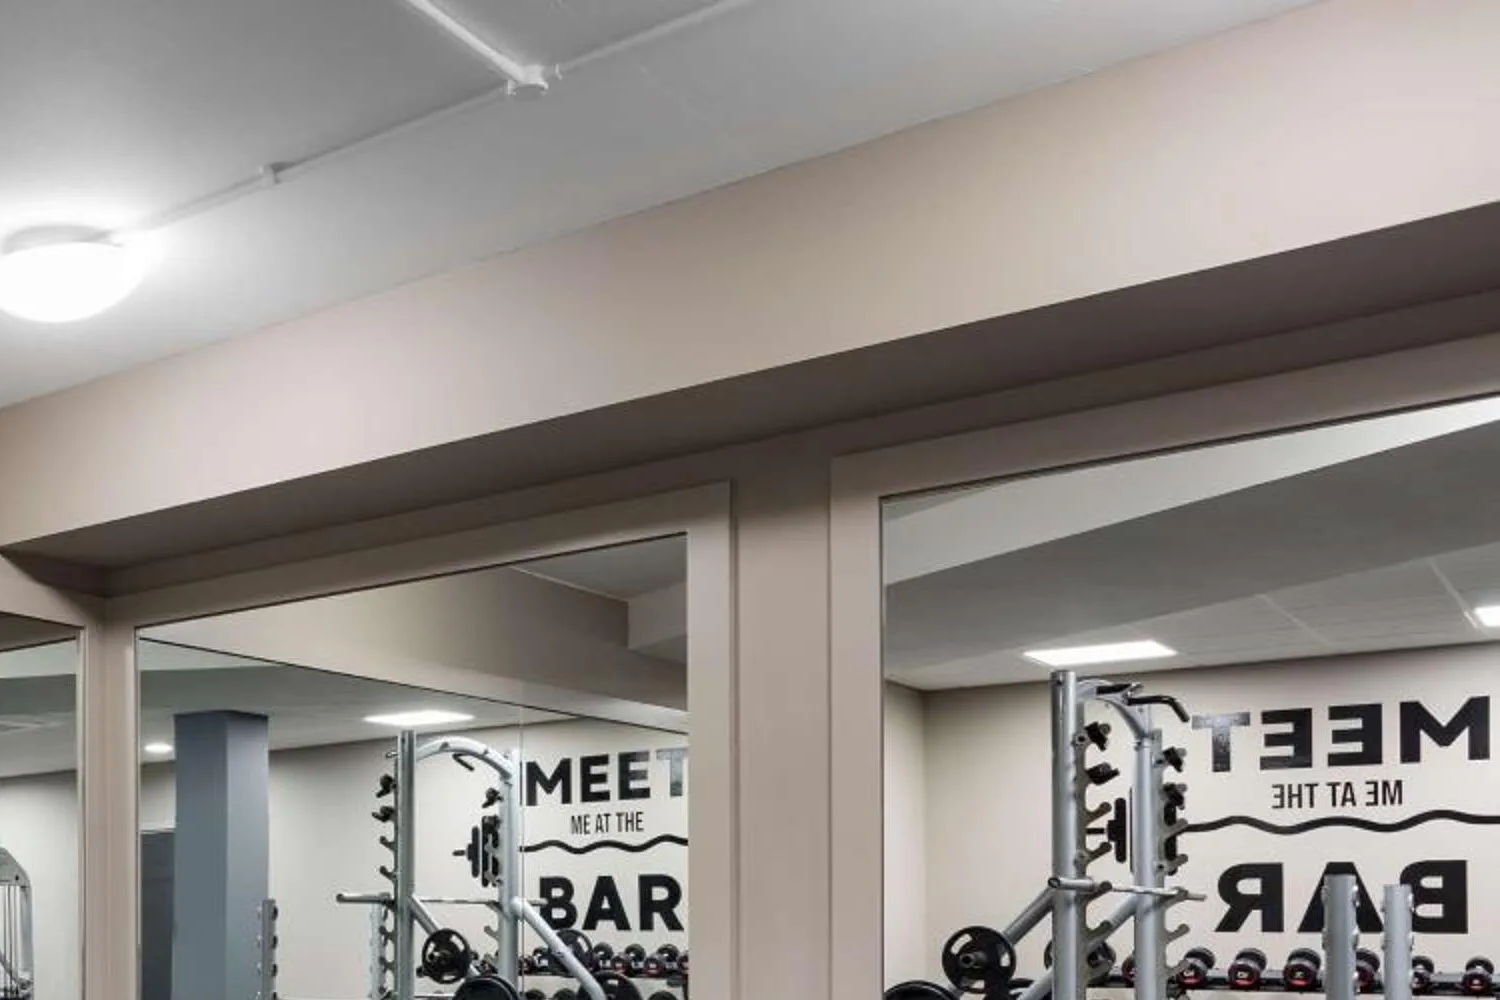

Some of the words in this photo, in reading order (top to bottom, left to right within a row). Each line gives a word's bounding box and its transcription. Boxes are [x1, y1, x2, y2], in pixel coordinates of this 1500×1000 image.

[525, 748, 688, 806] MEET
[571, 814, 590, 835] ME
[596, 812, 611, 833] AT
[615, 811, 644, 832] THE
[539, 874, 684, 931] BAR
